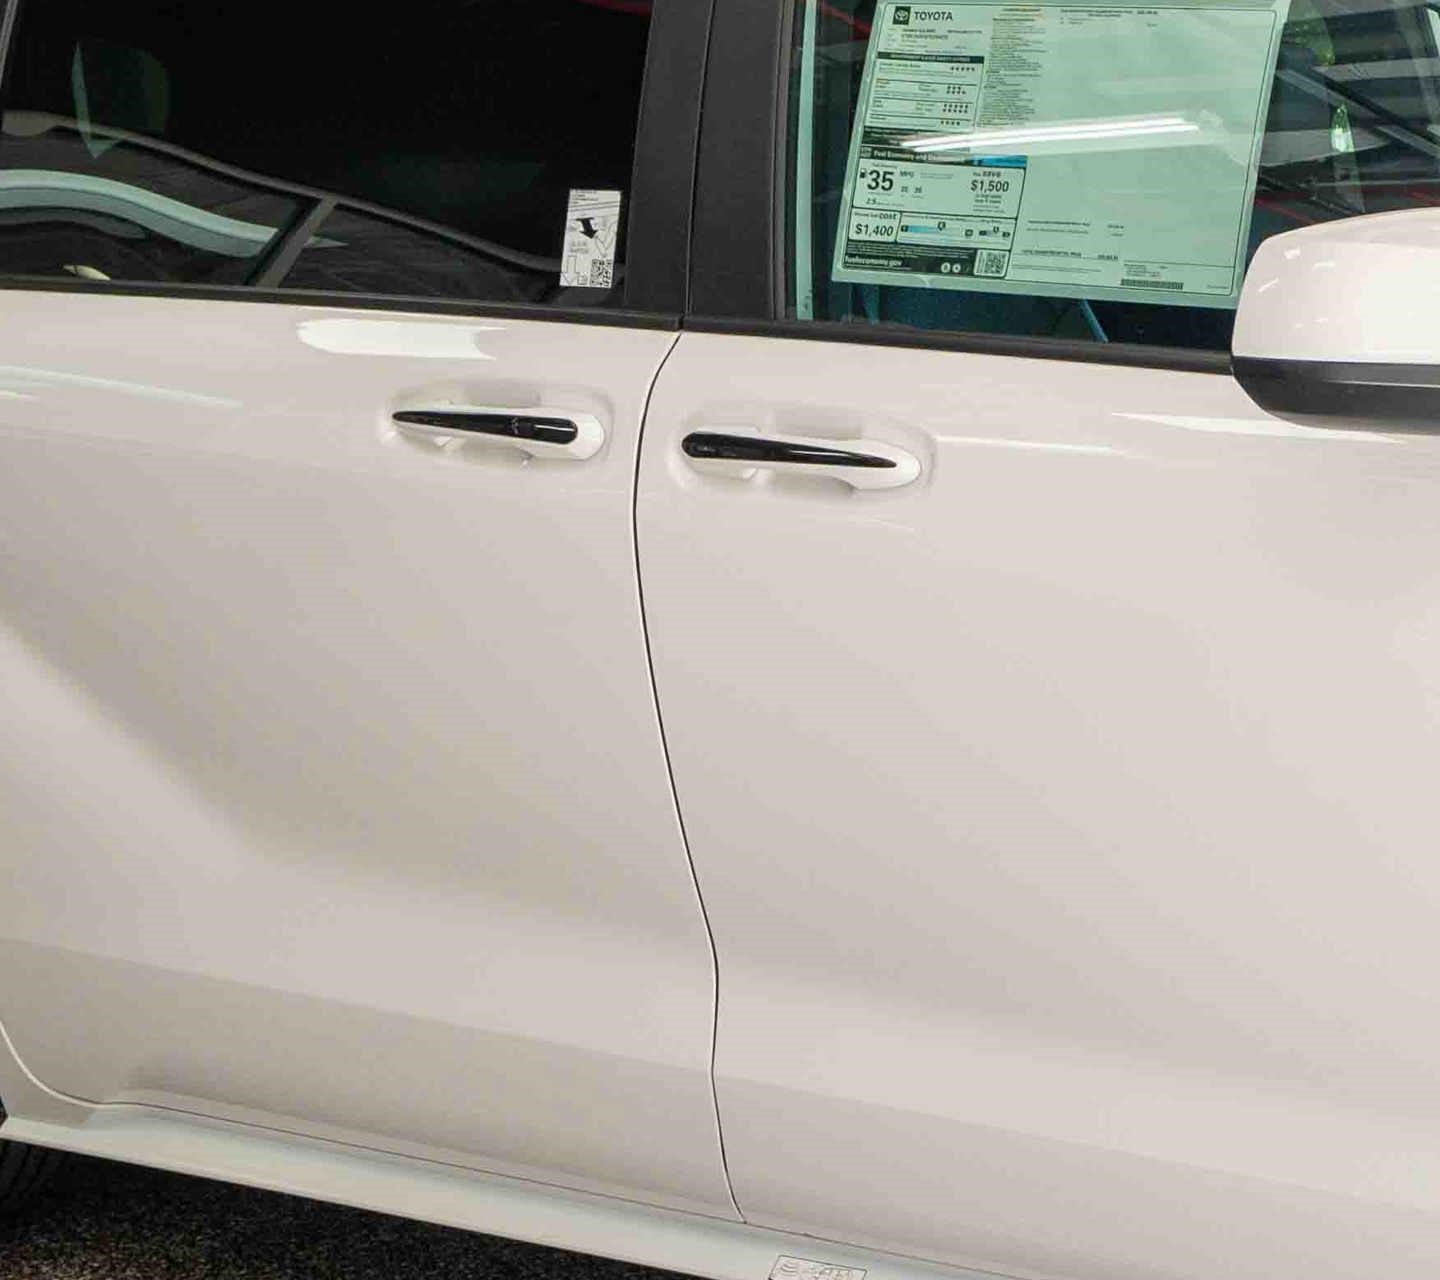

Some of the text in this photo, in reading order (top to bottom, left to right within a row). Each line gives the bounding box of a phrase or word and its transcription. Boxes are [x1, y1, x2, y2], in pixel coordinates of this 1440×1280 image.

[913, 11, 953, 21] TOYOTA
[867, 170, 894, 191] 35
[970, 180, 1009, 193] $1,500
[855, 223, 894, 237] $1,400
